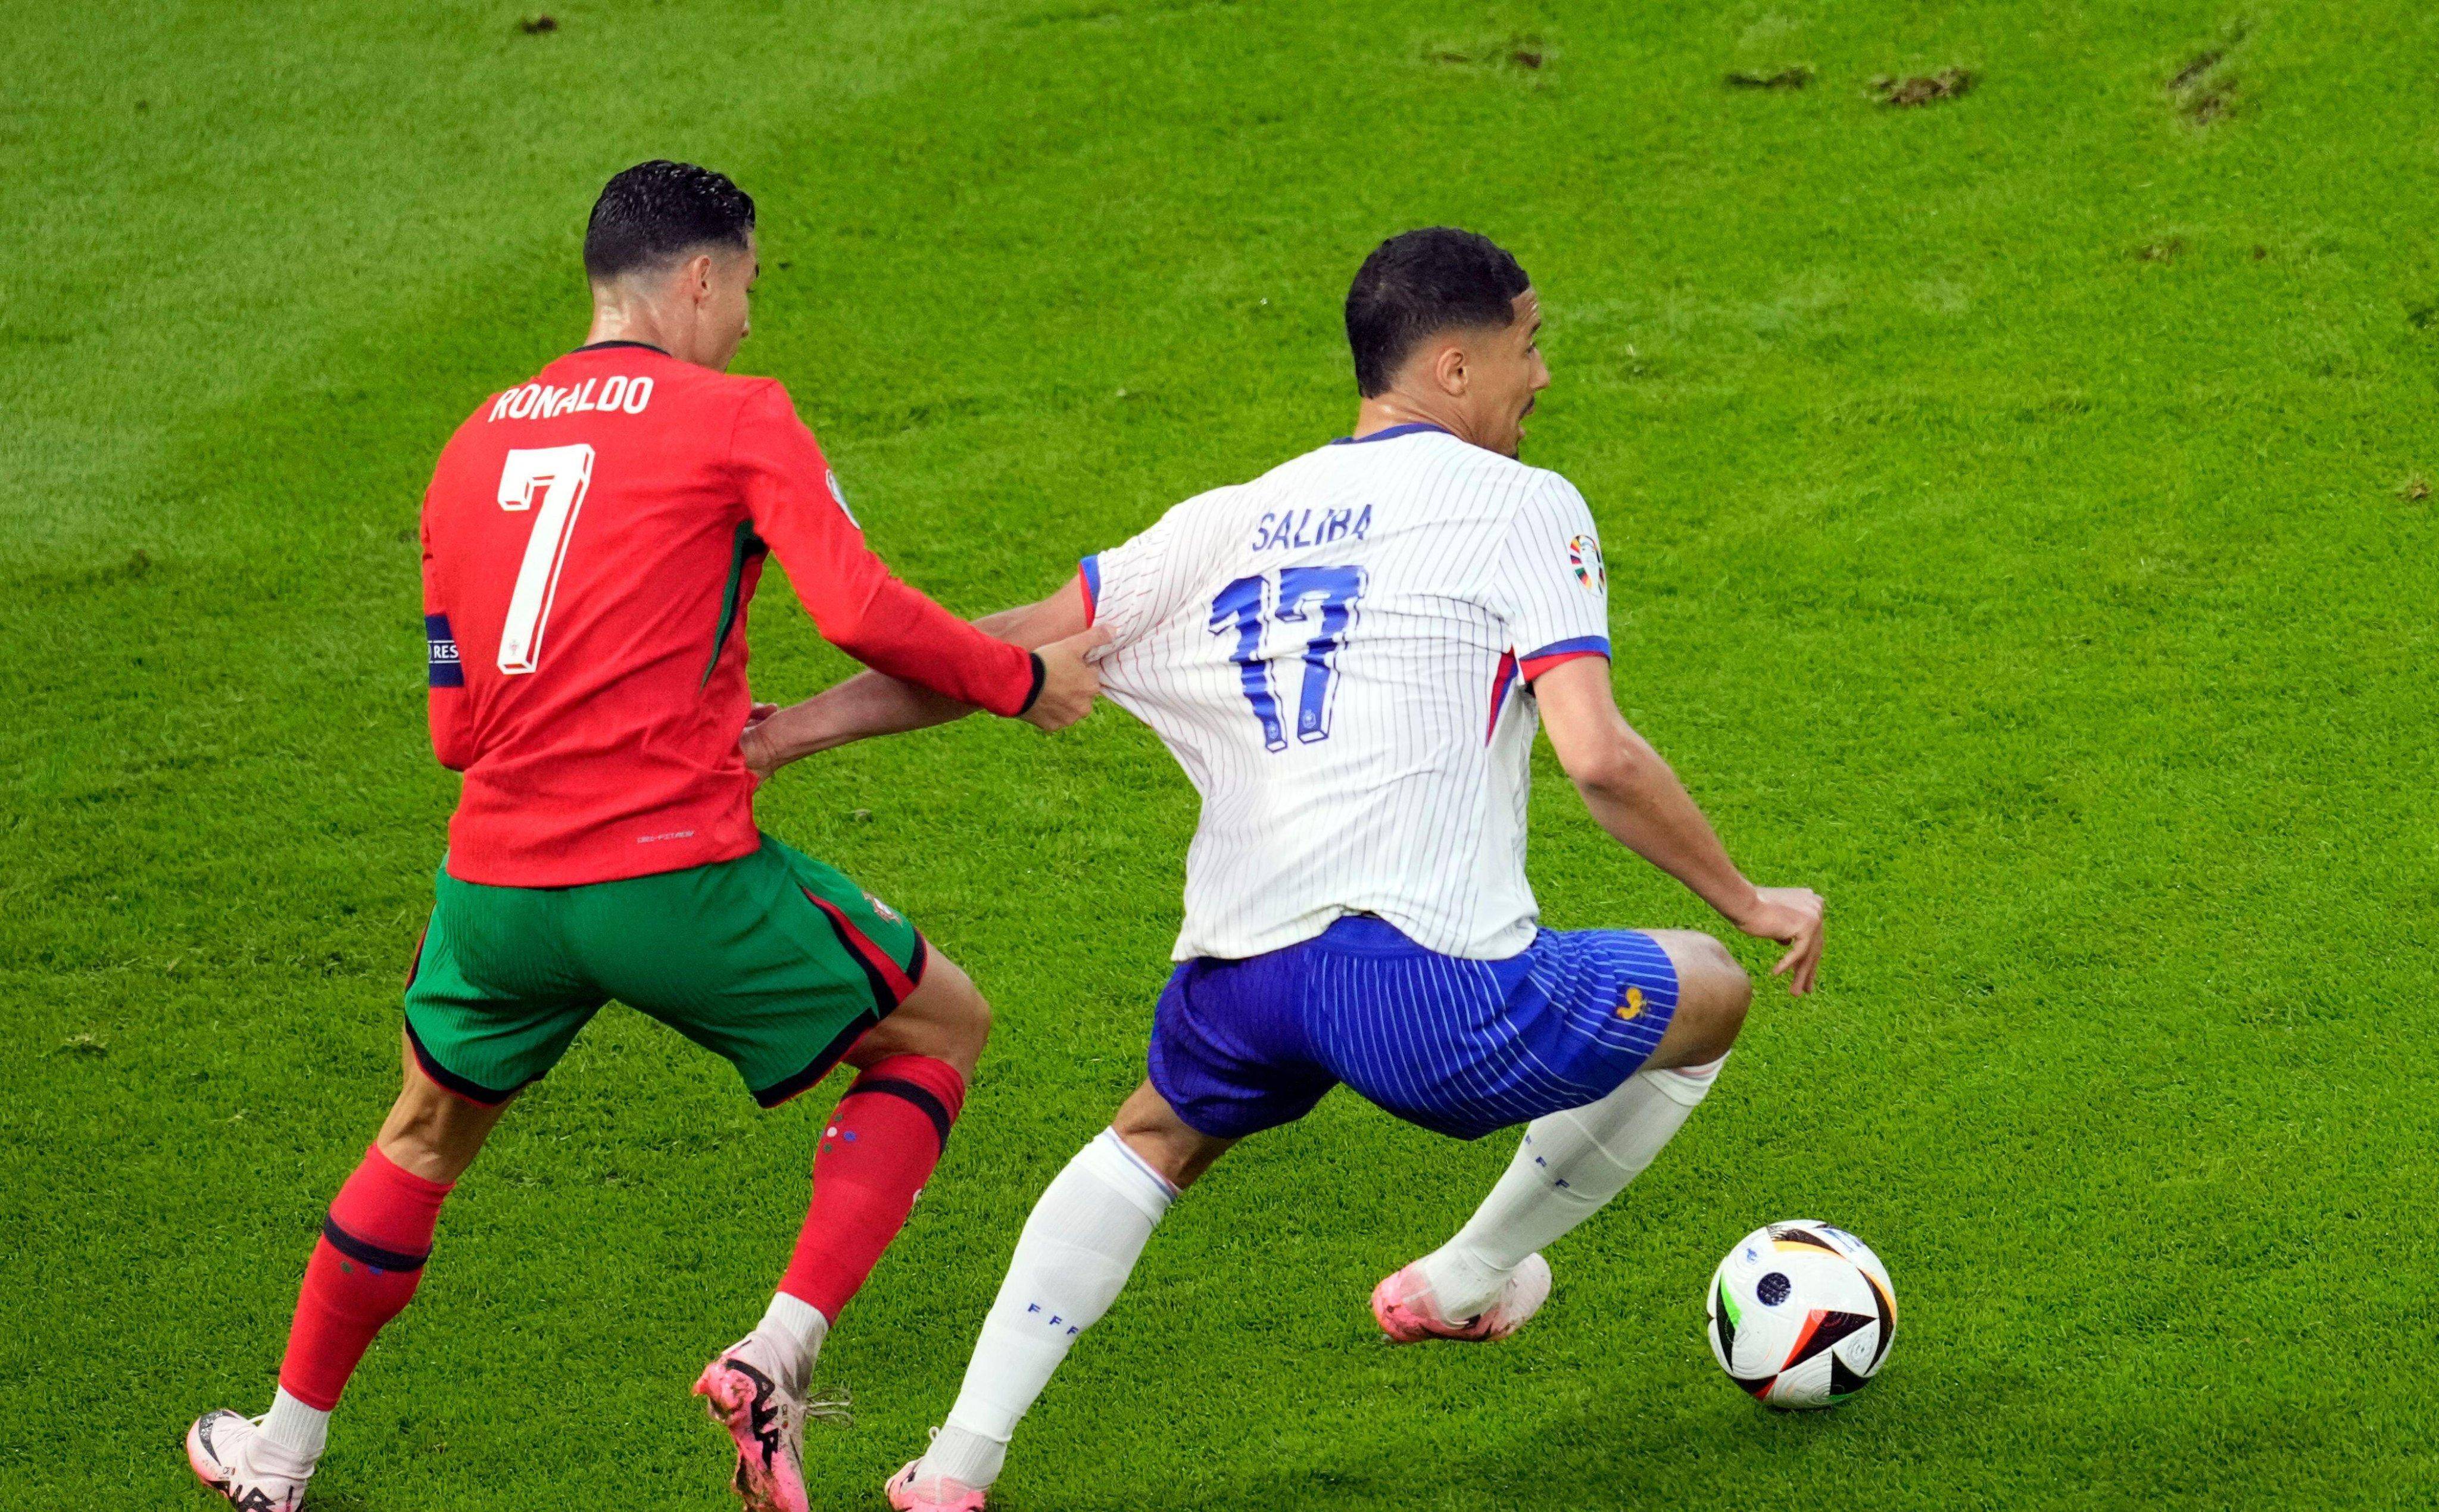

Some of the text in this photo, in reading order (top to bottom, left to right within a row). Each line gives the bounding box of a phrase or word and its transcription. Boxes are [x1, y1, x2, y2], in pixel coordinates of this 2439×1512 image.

[488, 376, 654, 422] RONALDO
[497, 443, 595, 674] 7
[1252, 504, 1372, 551] SALIBA
[1208, 565, 1369, 753] 17
